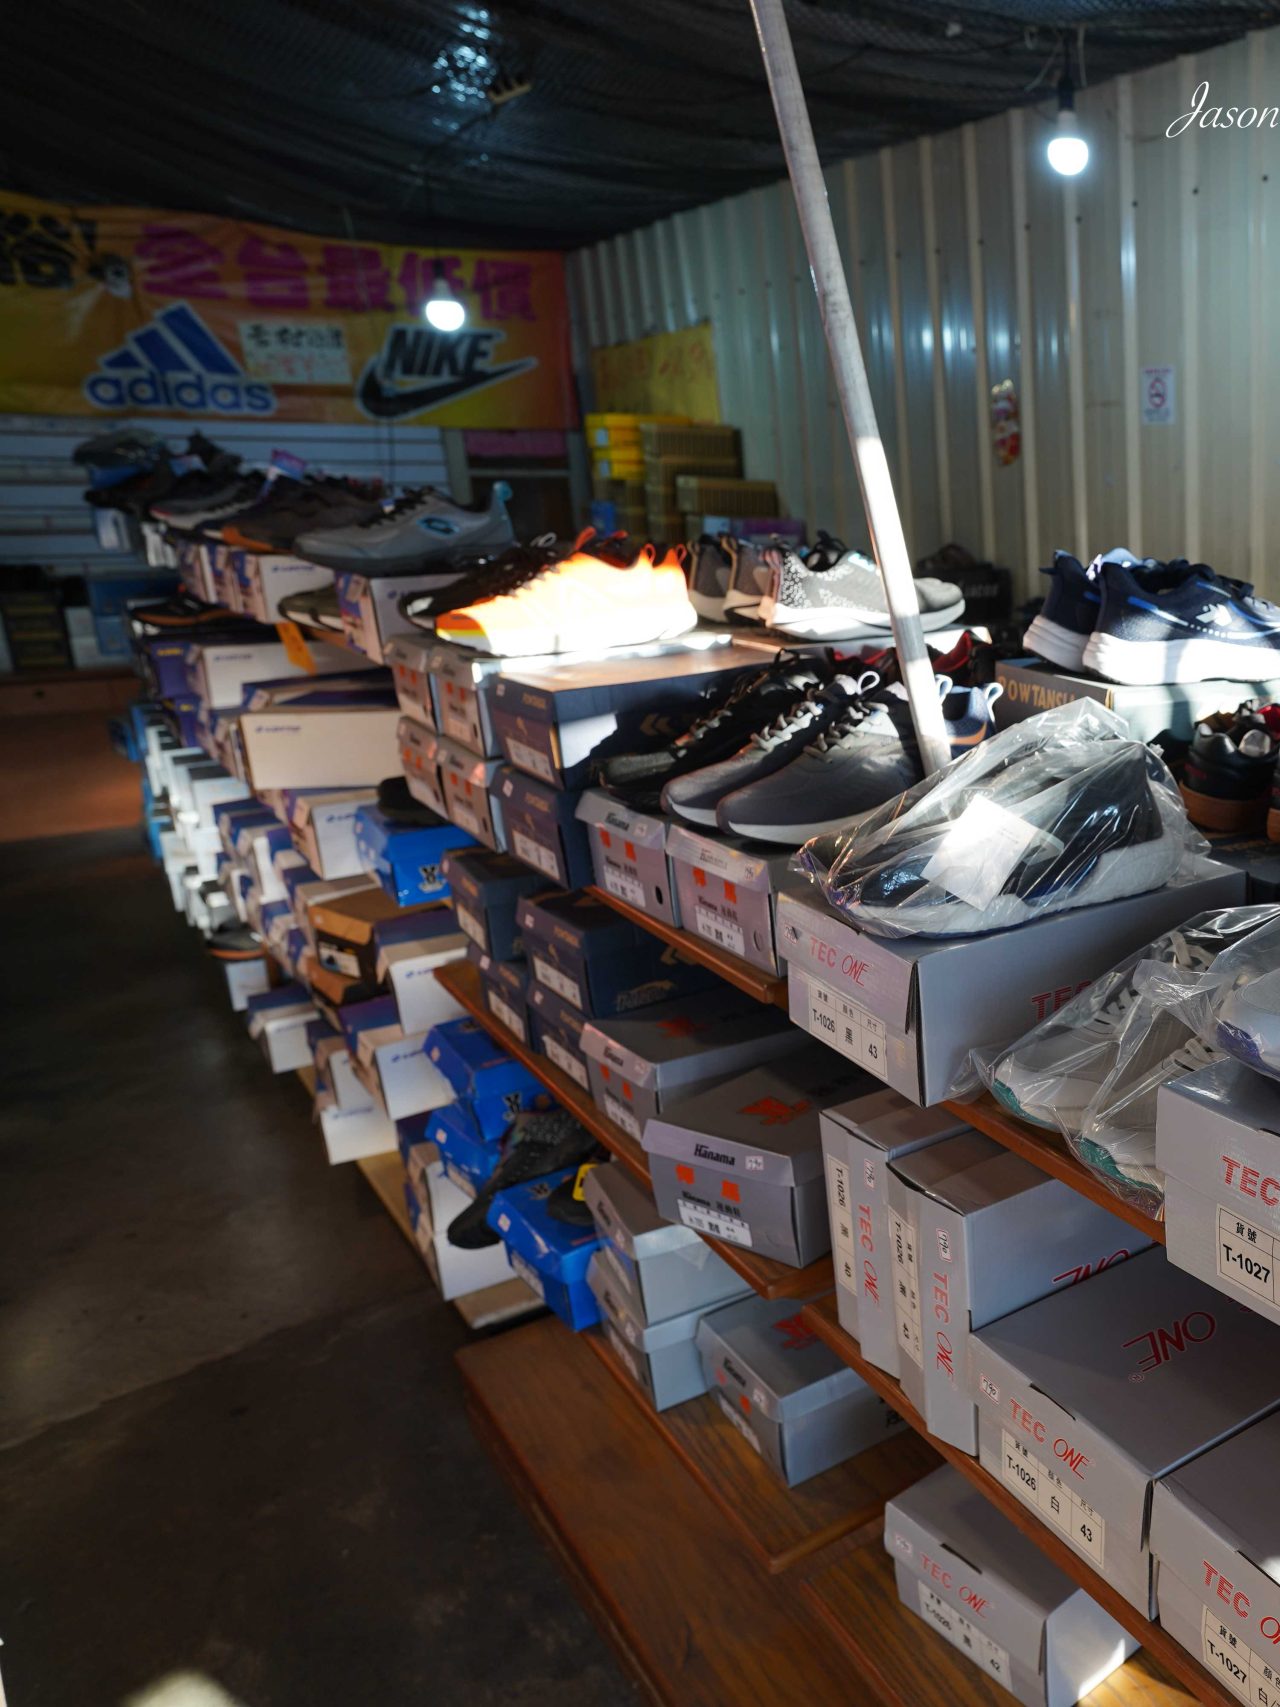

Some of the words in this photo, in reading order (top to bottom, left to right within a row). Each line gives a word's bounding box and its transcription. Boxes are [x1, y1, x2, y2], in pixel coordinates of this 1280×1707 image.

[384, 327, 494, 377] NIKE
[86, 372, 273, 413] adidas
[810, 936, 837, 968] TEC
[842, 954, 870, 987] ONE
[812, 1008, 836, 1033] T-1026
[868, 1043, 878, 1060] 43
[858, 1203, 875, 1253] TEC
[1235, 1221, 1258, 1245] 貨號
[845, 1260, 852, 1278] 40
[863, 1259, 881, 1303] ONE
[1222, 1243, 1271, 1284] T-1027
[933, 1270, 950, 1325] TEC
[936, 1331, 954, 1381] ONE
[1122, 1311, 1217, 1374] ONE
[1010, 1398, 1047, 1445] TEC
[1053, 1437, 1090, 1480] ONE
[1007, 1455, 1037, 1491] T-1026
[1050, 1495, 1061, 1515] 白
[1080, 1523, 1094, 1543] 43
[921, 1551, 953, 1590] TEC
[958, 1583, 988, 1620] ONE
[1203, 1560, 1252, 1619] TEC
[1207, 1639, 1248, 1684] T-1027
[1219, 1624, 1238, 1649] 貨號
